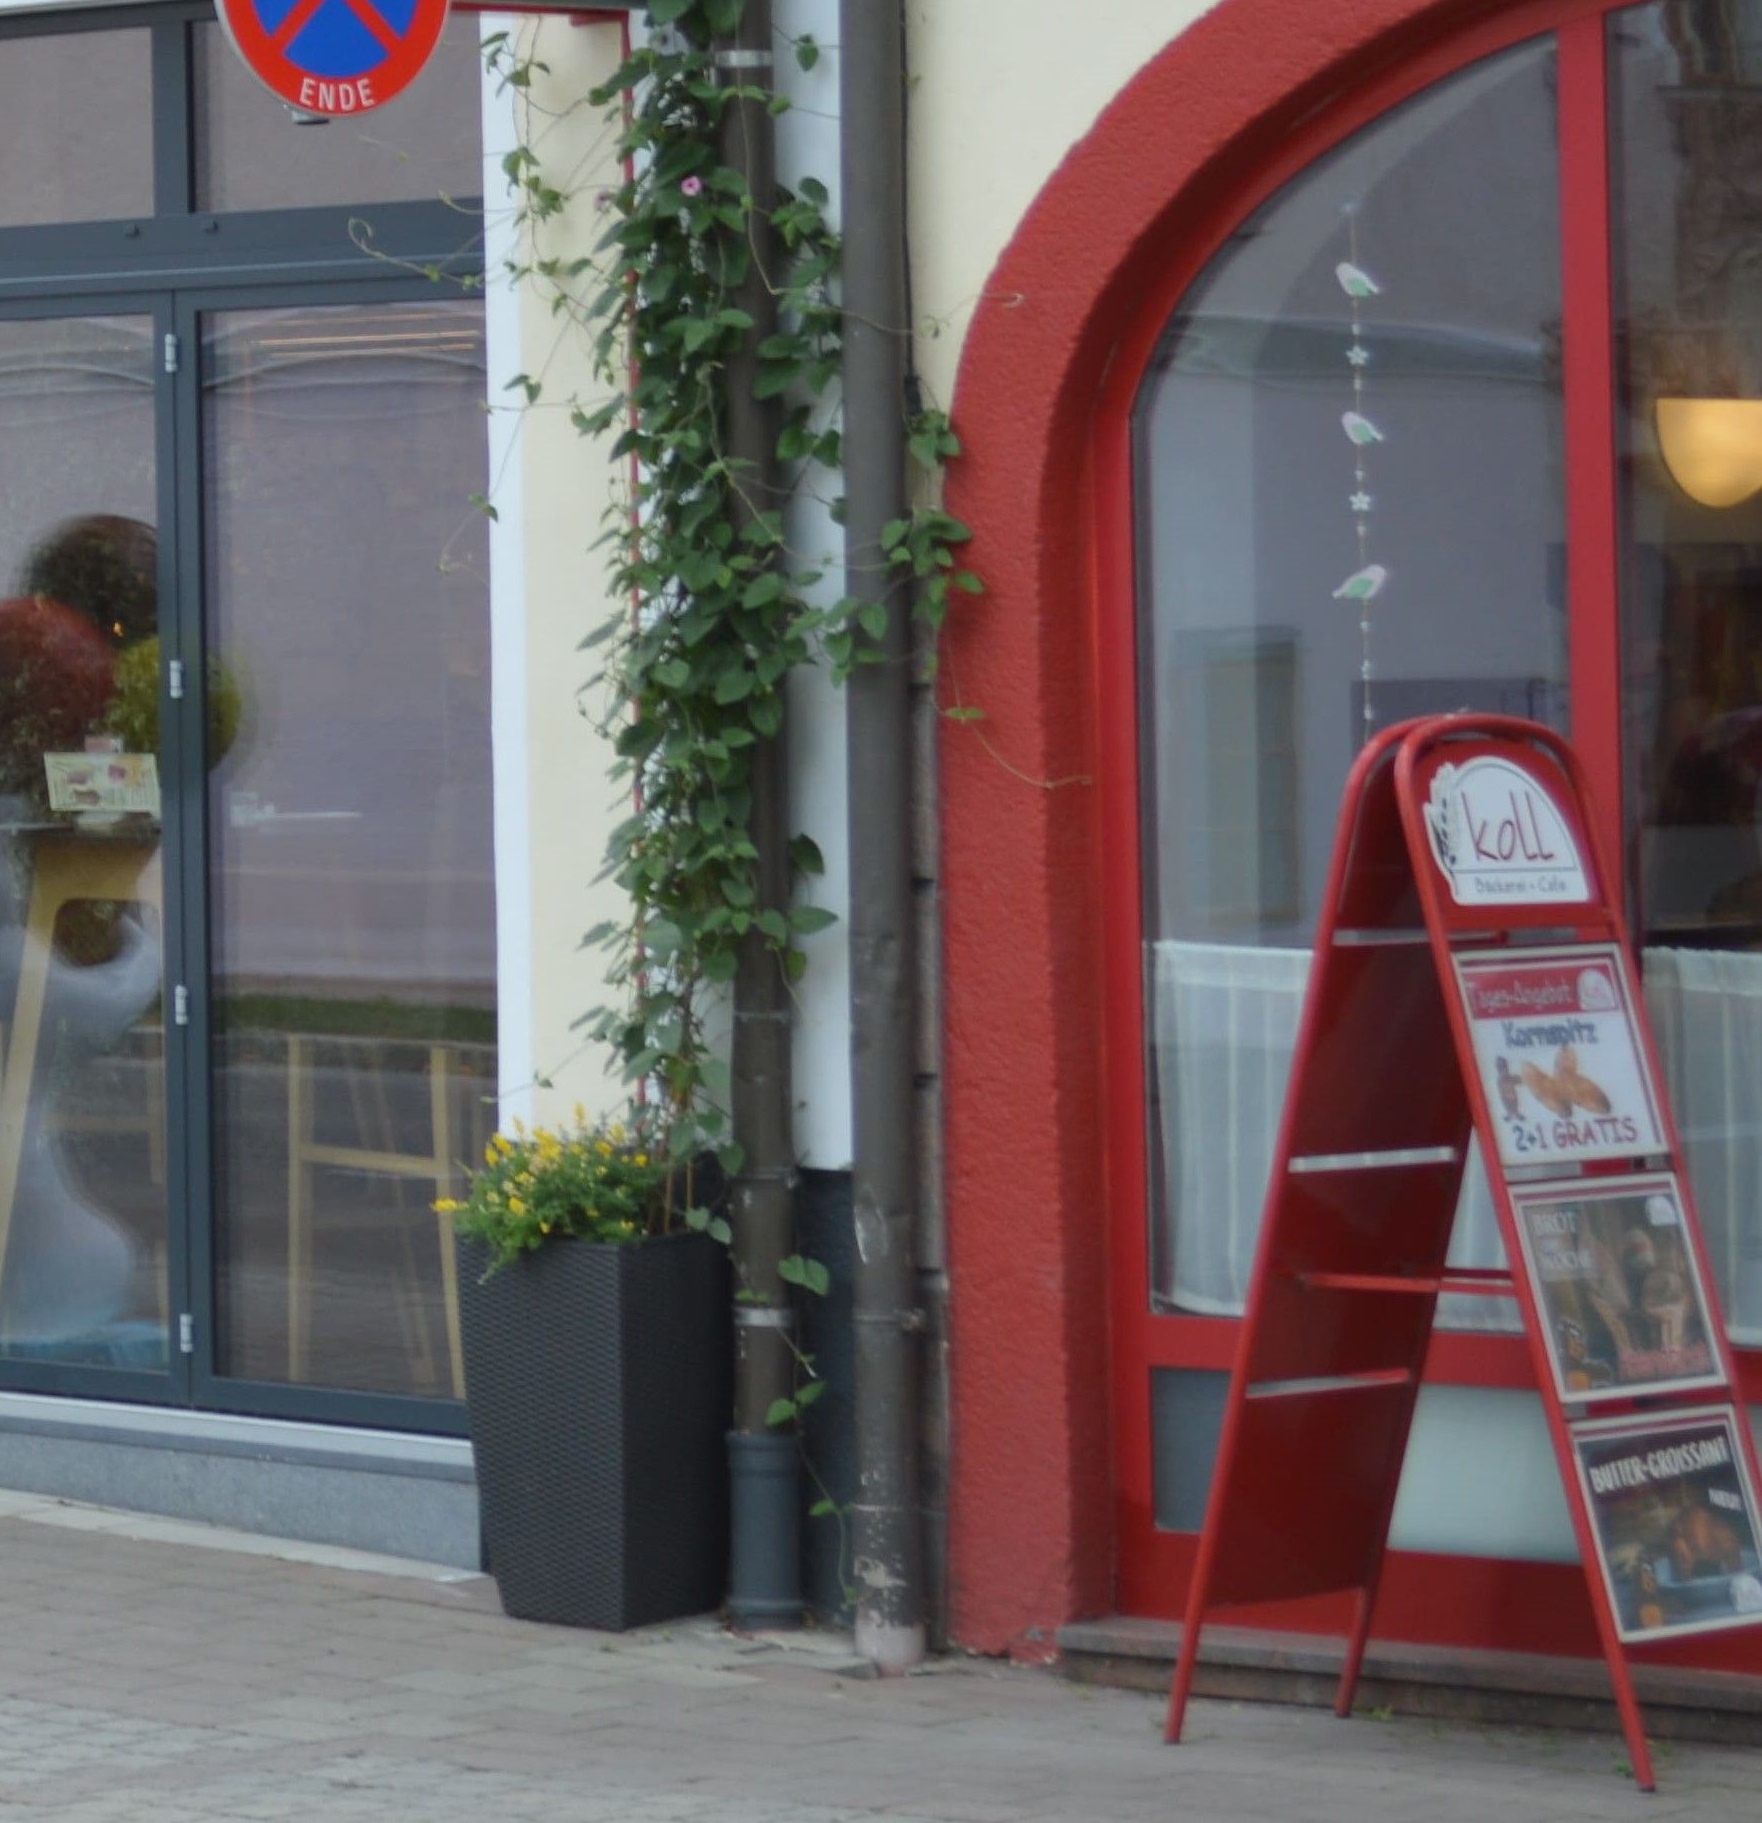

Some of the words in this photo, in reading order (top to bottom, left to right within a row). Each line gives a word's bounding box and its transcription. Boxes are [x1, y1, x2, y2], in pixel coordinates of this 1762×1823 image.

[299, 77, 376, 112] ENDE
[1460, 790, 1555, 862] koll
[1512, 1123, 1549, 1152] 2+1
[1553, 1118, 1638, 1147] GRATIS
[1588, 1434, 1729, 1494] BUTTER-CROISSANT
